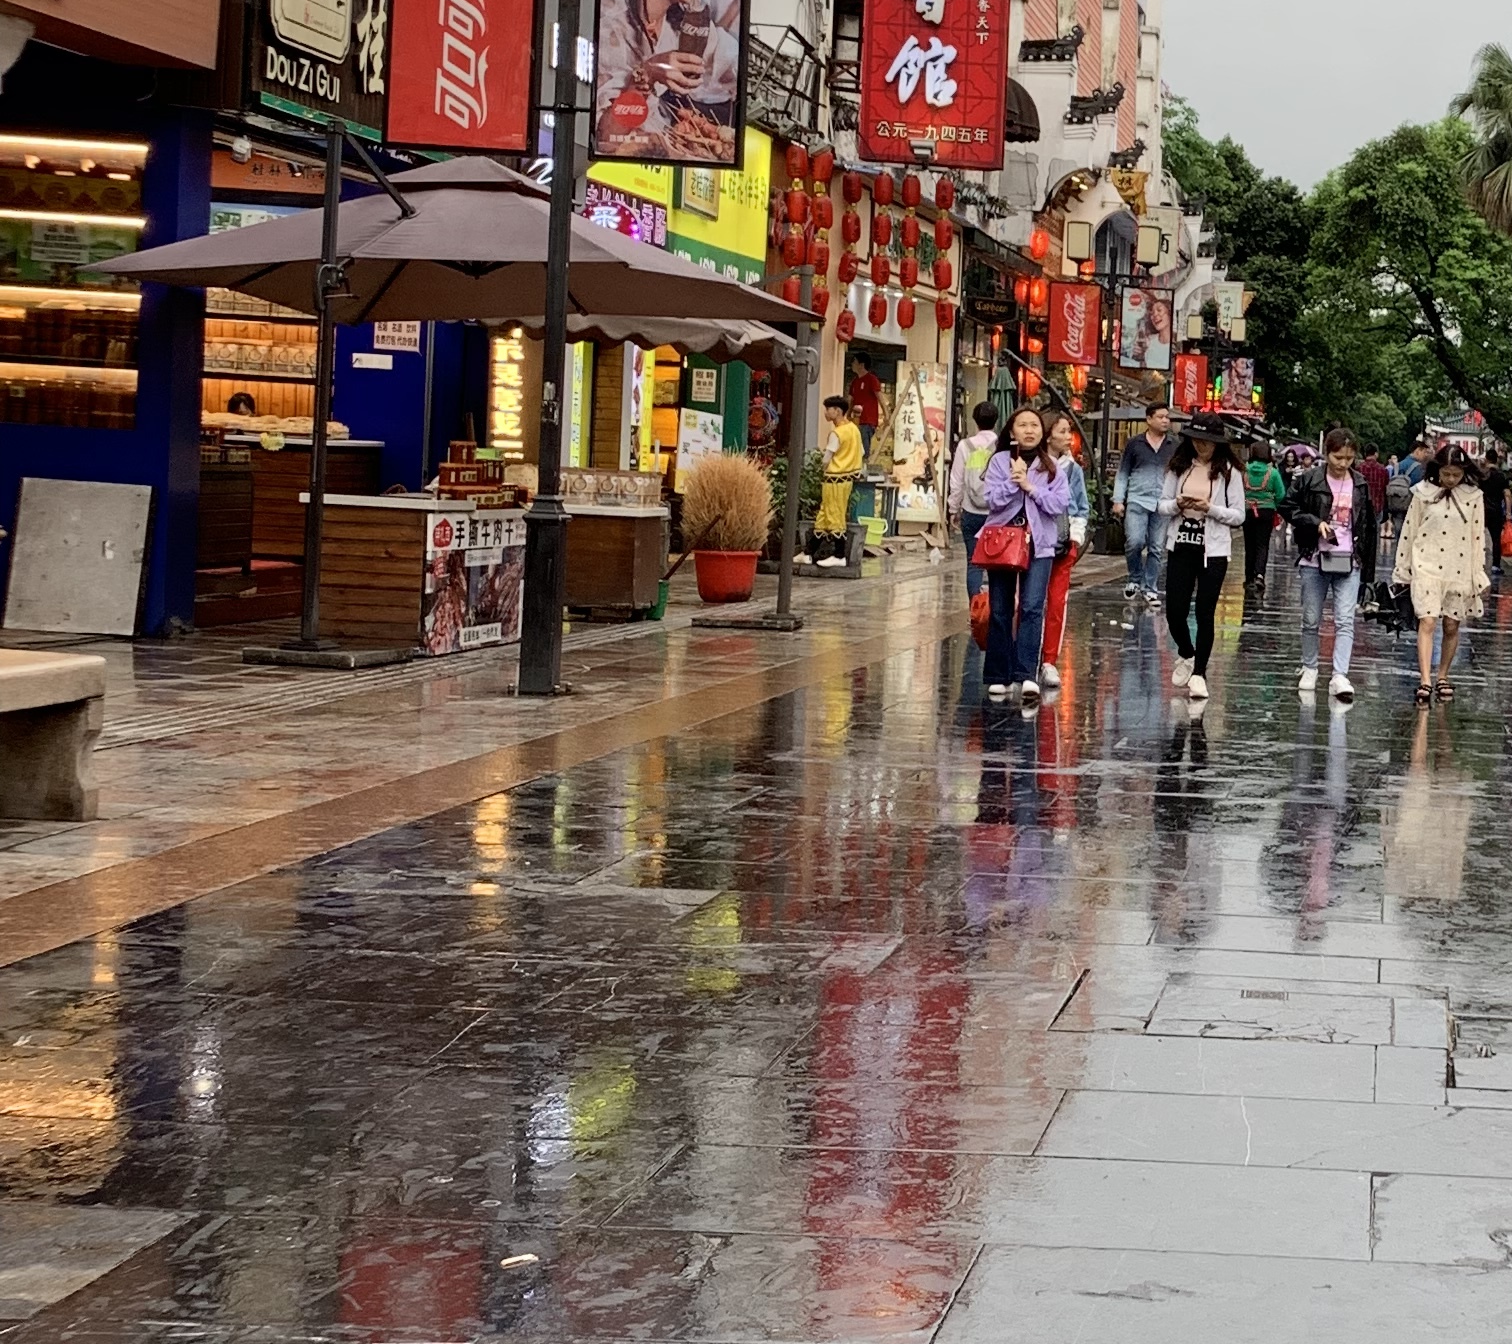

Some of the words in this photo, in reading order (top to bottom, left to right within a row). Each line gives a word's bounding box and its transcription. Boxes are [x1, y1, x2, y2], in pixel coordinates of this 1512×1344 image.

[876, 120, 989, 144] 公元一九四五年
[1062, 290, 1087, 358] Coca-Cola
